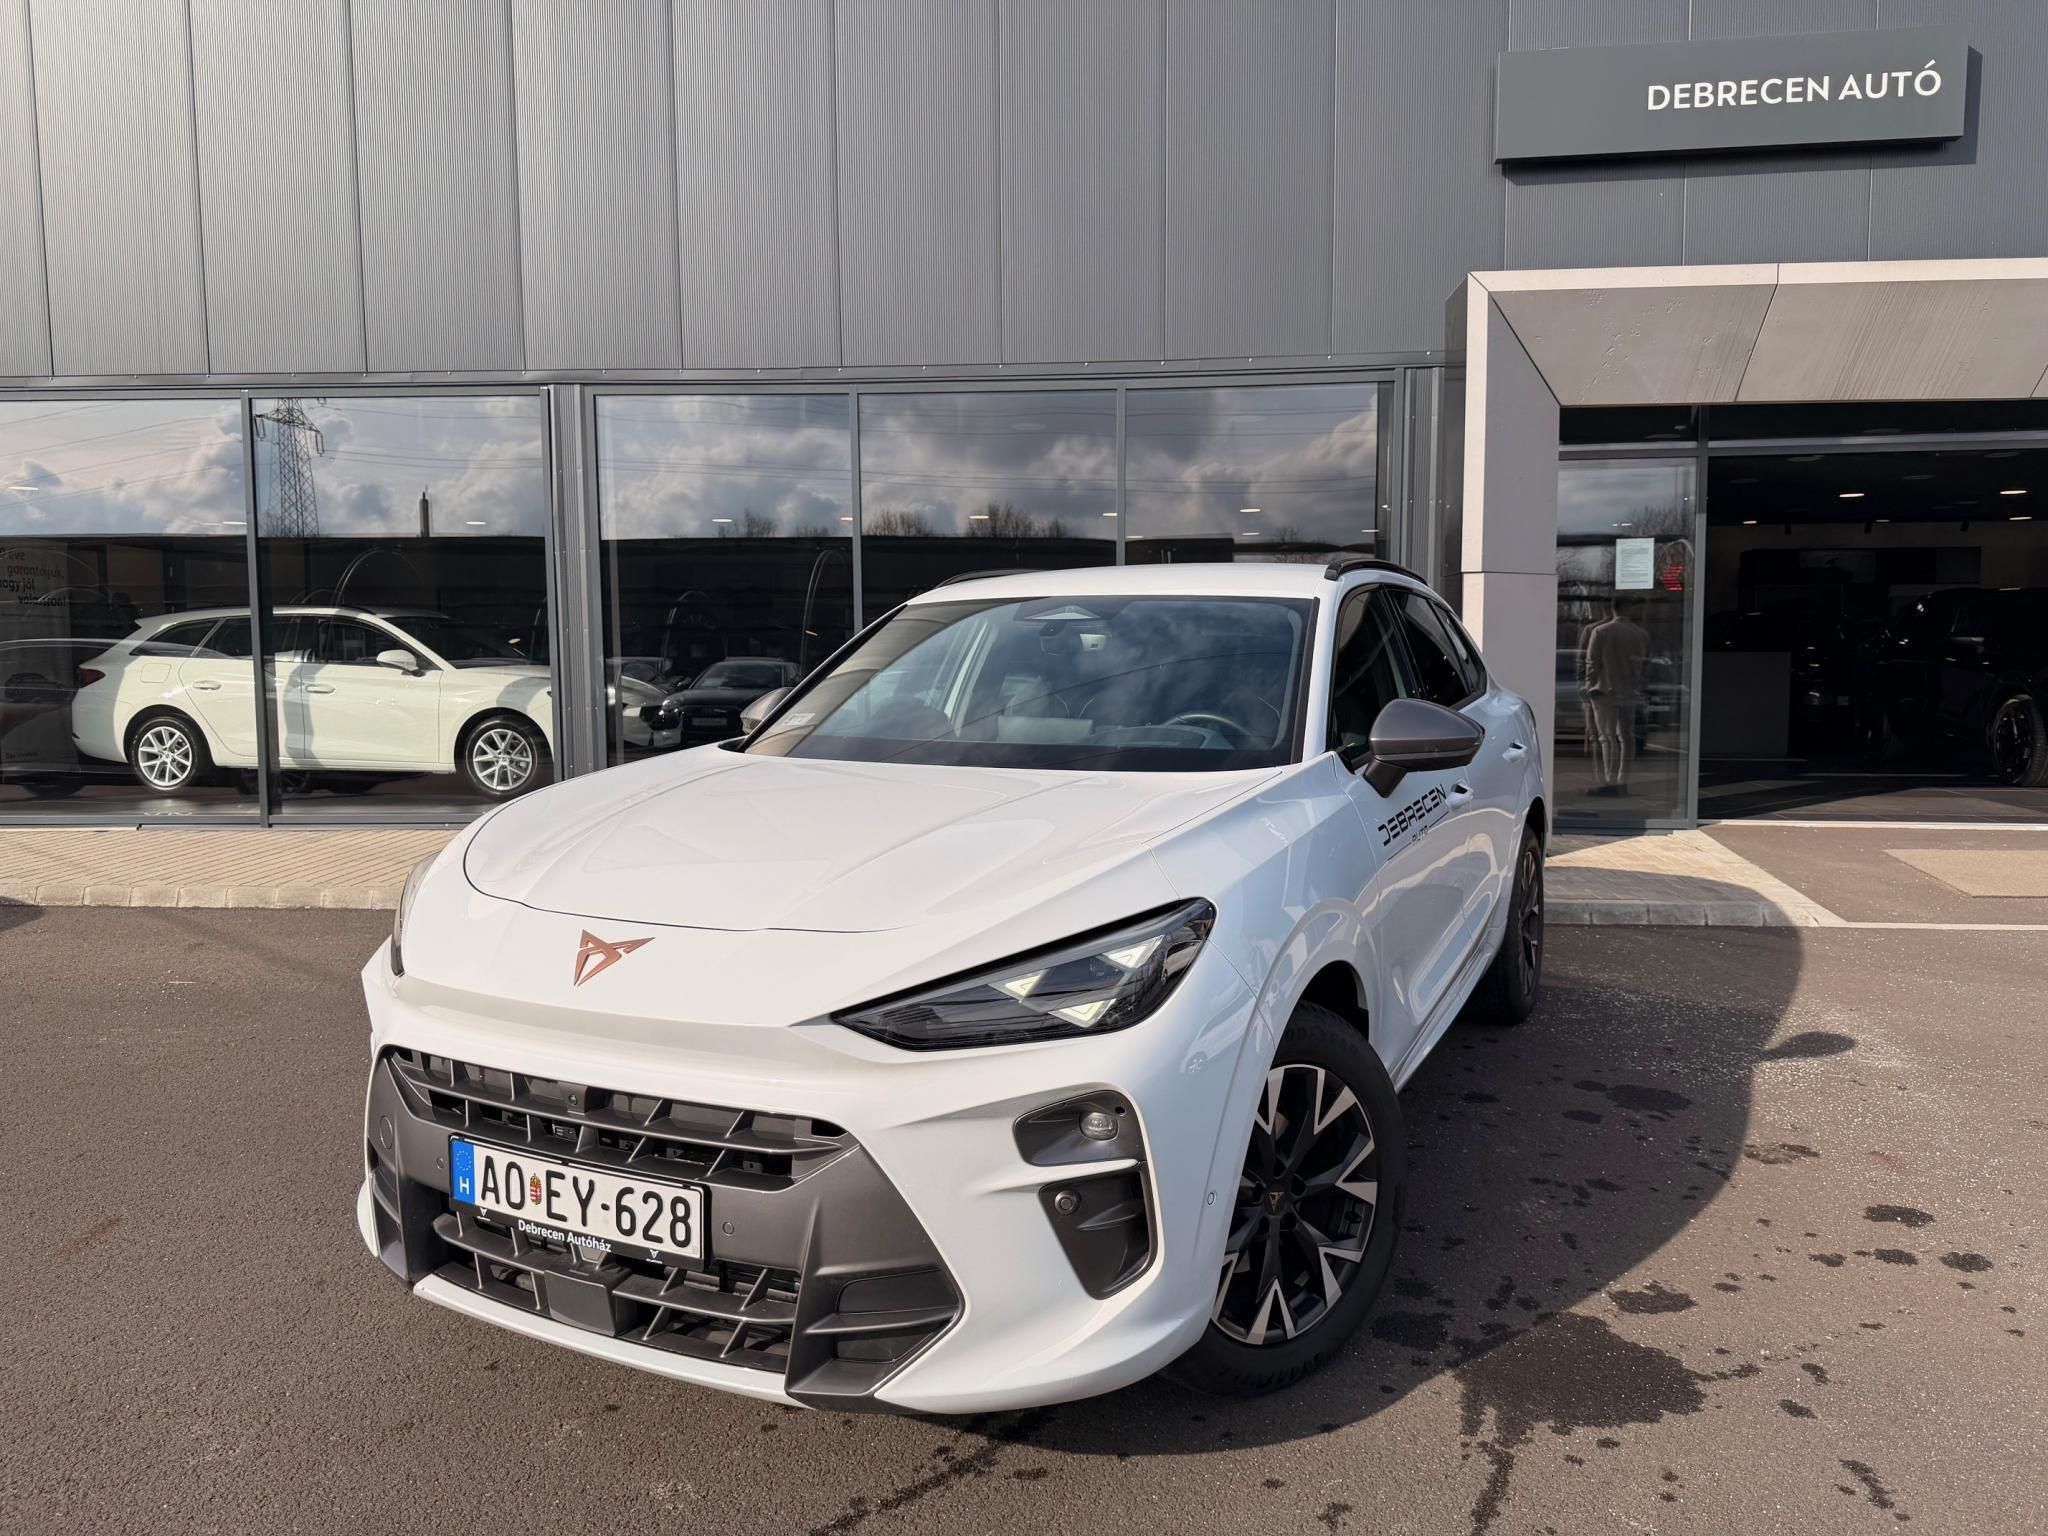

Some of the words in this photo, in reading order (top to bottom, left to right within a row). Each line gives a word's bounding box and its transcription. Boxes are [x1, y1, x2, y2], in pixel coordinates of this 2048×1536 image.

[1647, 75, 1829, 110] DEBRECEN
[1838, 59, 1942, 101] AUTÓ
[1377, 783, 1447, 847] DEBRECEN
[459, 1176, 470, 1195] H
[481, 1155, 526, 1211] AO
[545, 1169, 692, 1249] EY-628
[518, 1219, 565, 1242] Debrecen
[567, 1232, 612, 1253] Autóház
